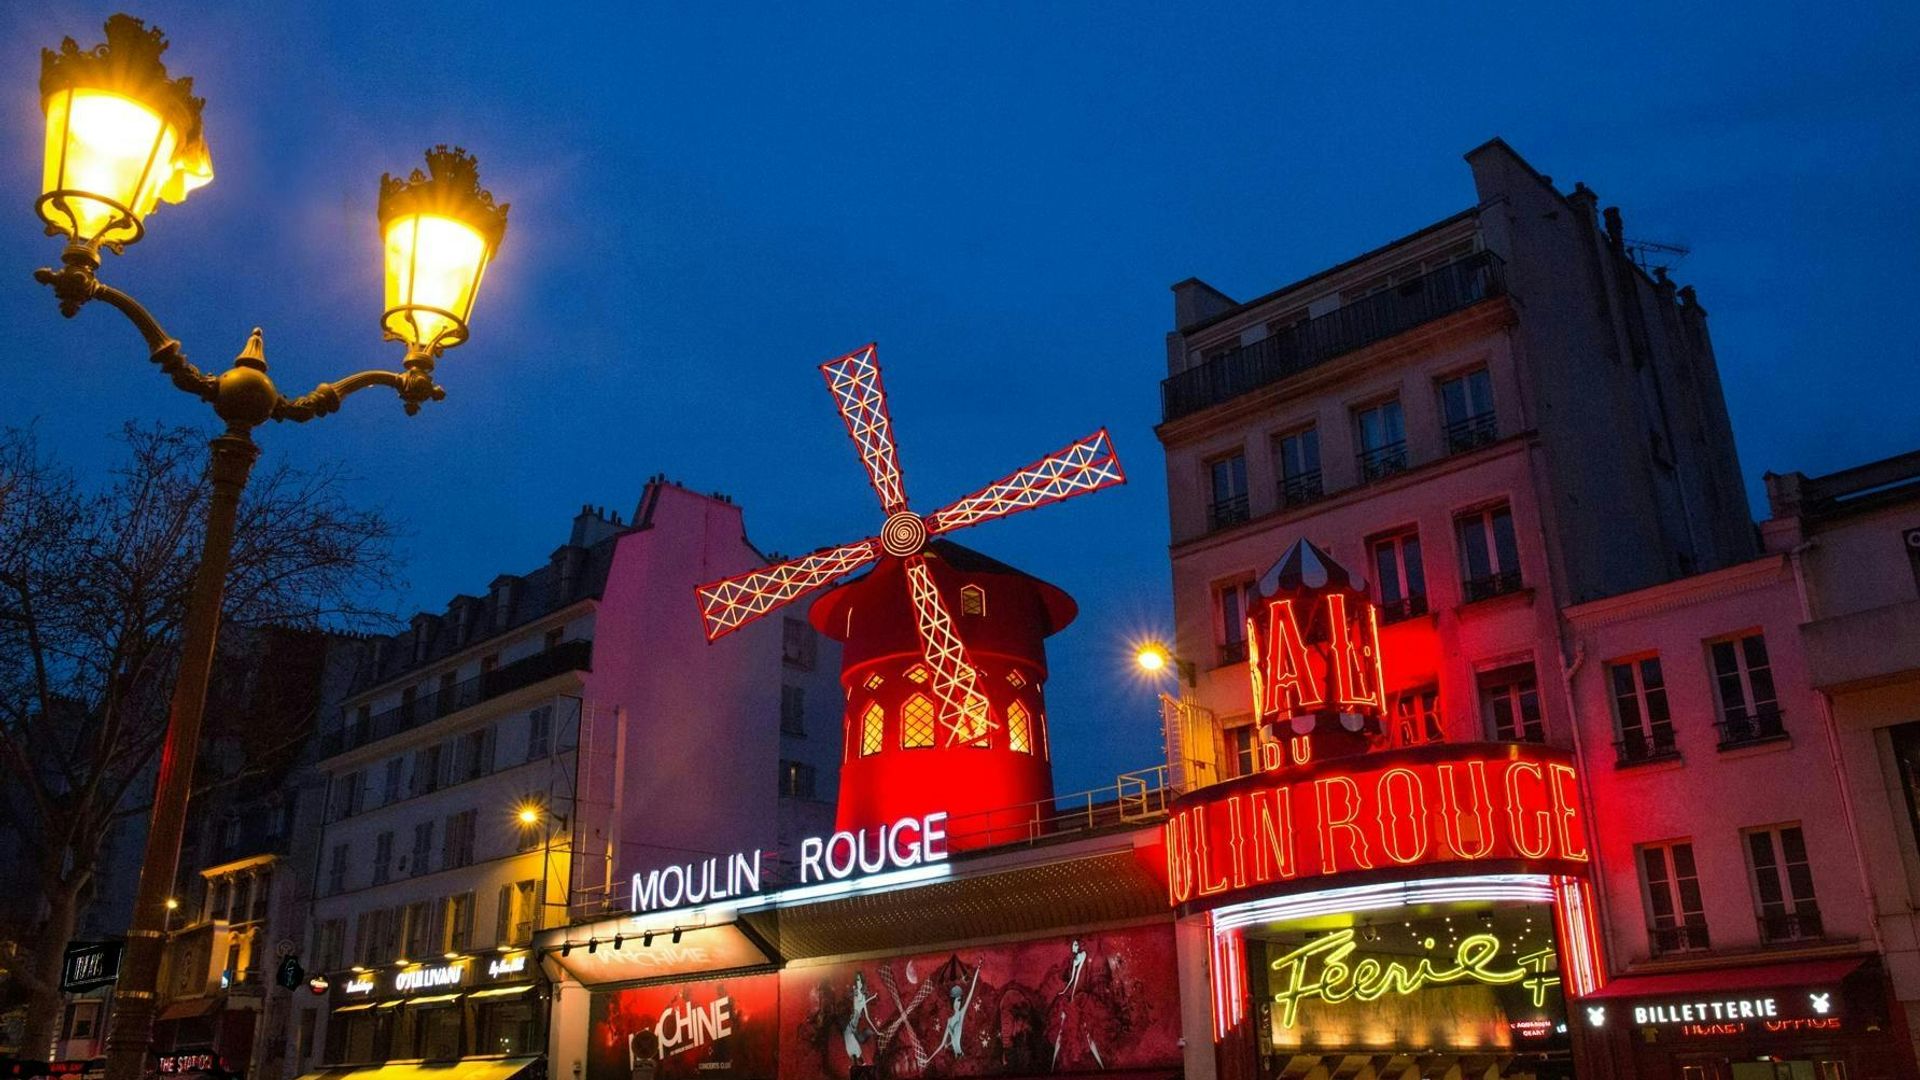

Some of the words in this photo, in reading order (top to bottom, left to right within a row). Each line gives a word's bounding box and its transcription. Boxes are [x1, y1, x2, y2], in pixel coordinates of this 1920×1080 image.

[1247, 594, 1379, 730] AL
[1263, 736, 1311, 771] DU
[631, 849, 761, 912] MOULIN
[800, 811, 949, 884] ROUGE
[1165, 786, 1297, 906] ULIN
[1313, 760, 1589, 875] ROUGE
[1271, 928, 1526, 1029] Féerie
[1635, 998, 1777, 1024] BILLETTERIE
[159, 1057, 174, 1072] THE
